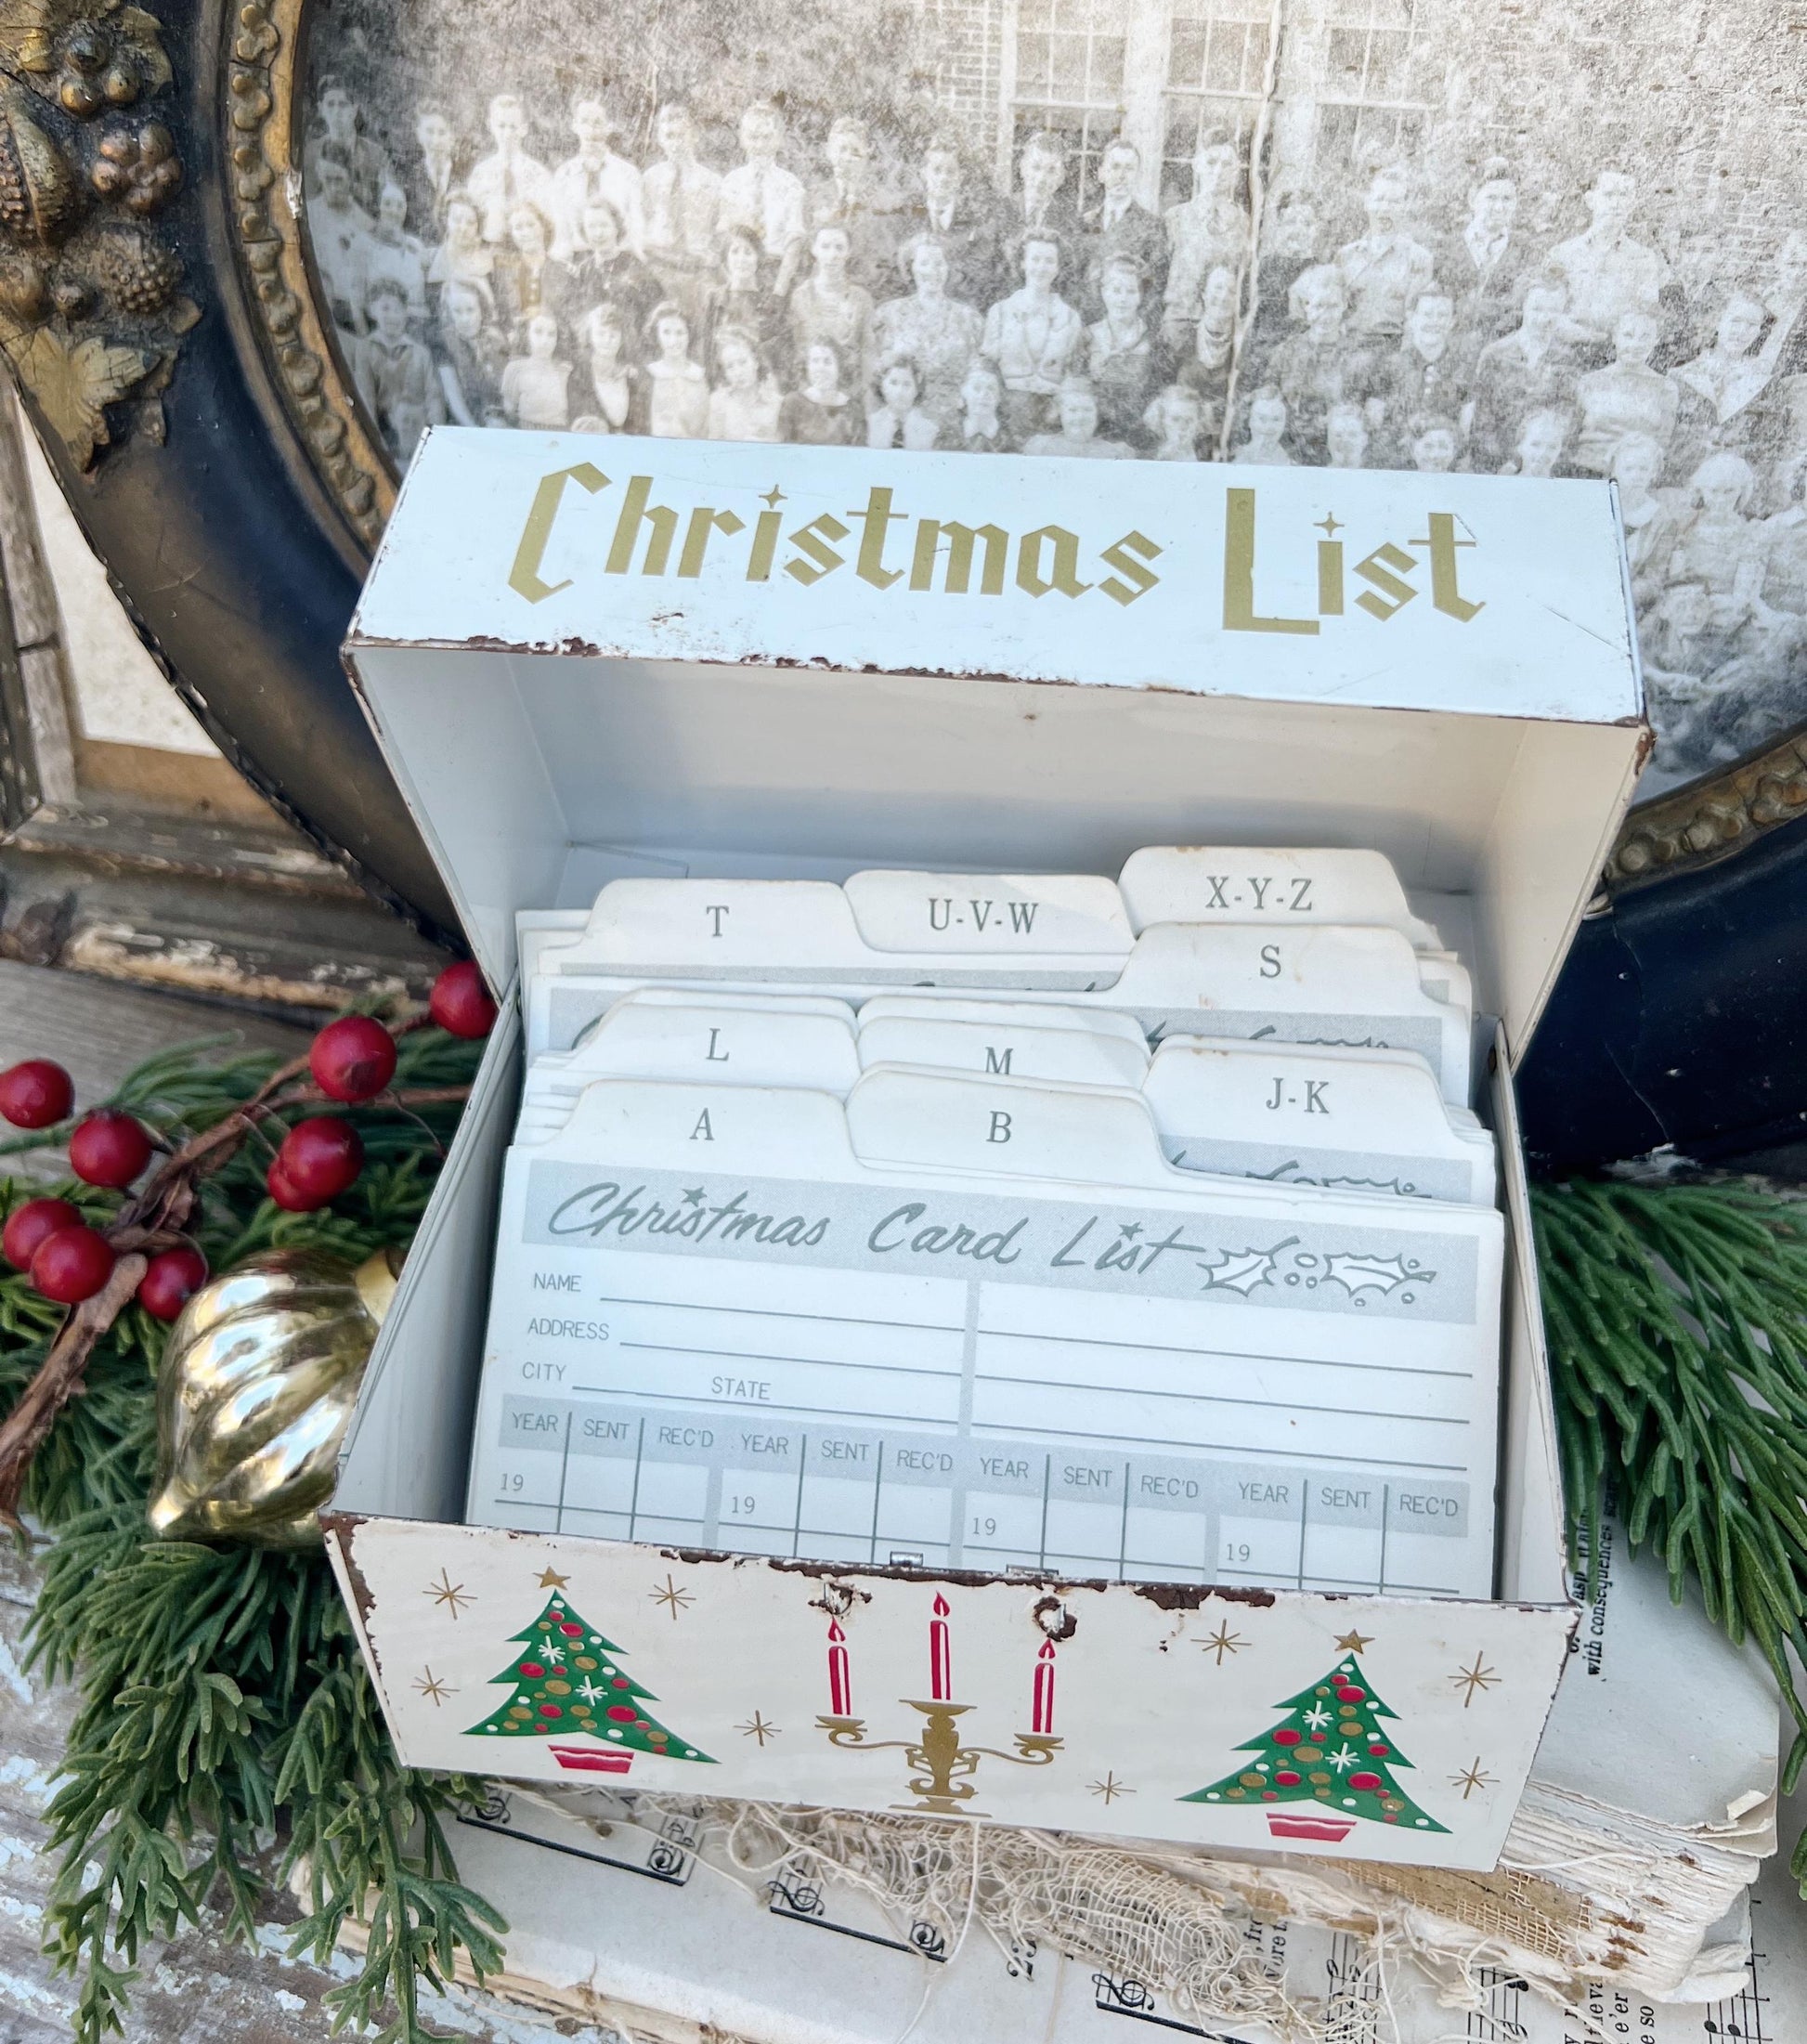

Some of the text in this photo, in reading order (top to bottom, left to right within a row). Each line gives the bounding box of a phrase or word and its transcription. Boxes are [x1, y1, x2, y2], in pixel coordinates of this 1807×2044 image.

[508, 462, 1487, 635] Christmas List
[1205, 876, 1313, 912] X-Y-Z
[706, 905, 731, 937] T
[928, 897, 1040, 934] U-V-W
[1259, 944, 1282, 979] S
[706, 1027, 730, 1061] L
[984, 1047, 1014, 1075] M
[1266, 1076, 1331, 1114] J-K
[689, 1107, 715, 1141] A
[985, 1111, 1013, 1144] B
[548, 1181, 1207, 1274] Christmas Card List
[532, 1271, 583, 1294] NAME
[526, 1318, 610, 1342] ADDRESS
[522, 1360, 772, 1400] CITY STATE
[512, 1412, 1459, 1517] YEAR SENT REC'D YEAR SENT REC'D YEAR SENT REC'D YEAR SENT REC'D
[500, 1473, 1251, 1563] 19 19 19 19
[1590, 1524, 1614, 1636] consequences
[1581, 1640, 1603, 1675] with
[1639, 2005, 1656, 2028] so
